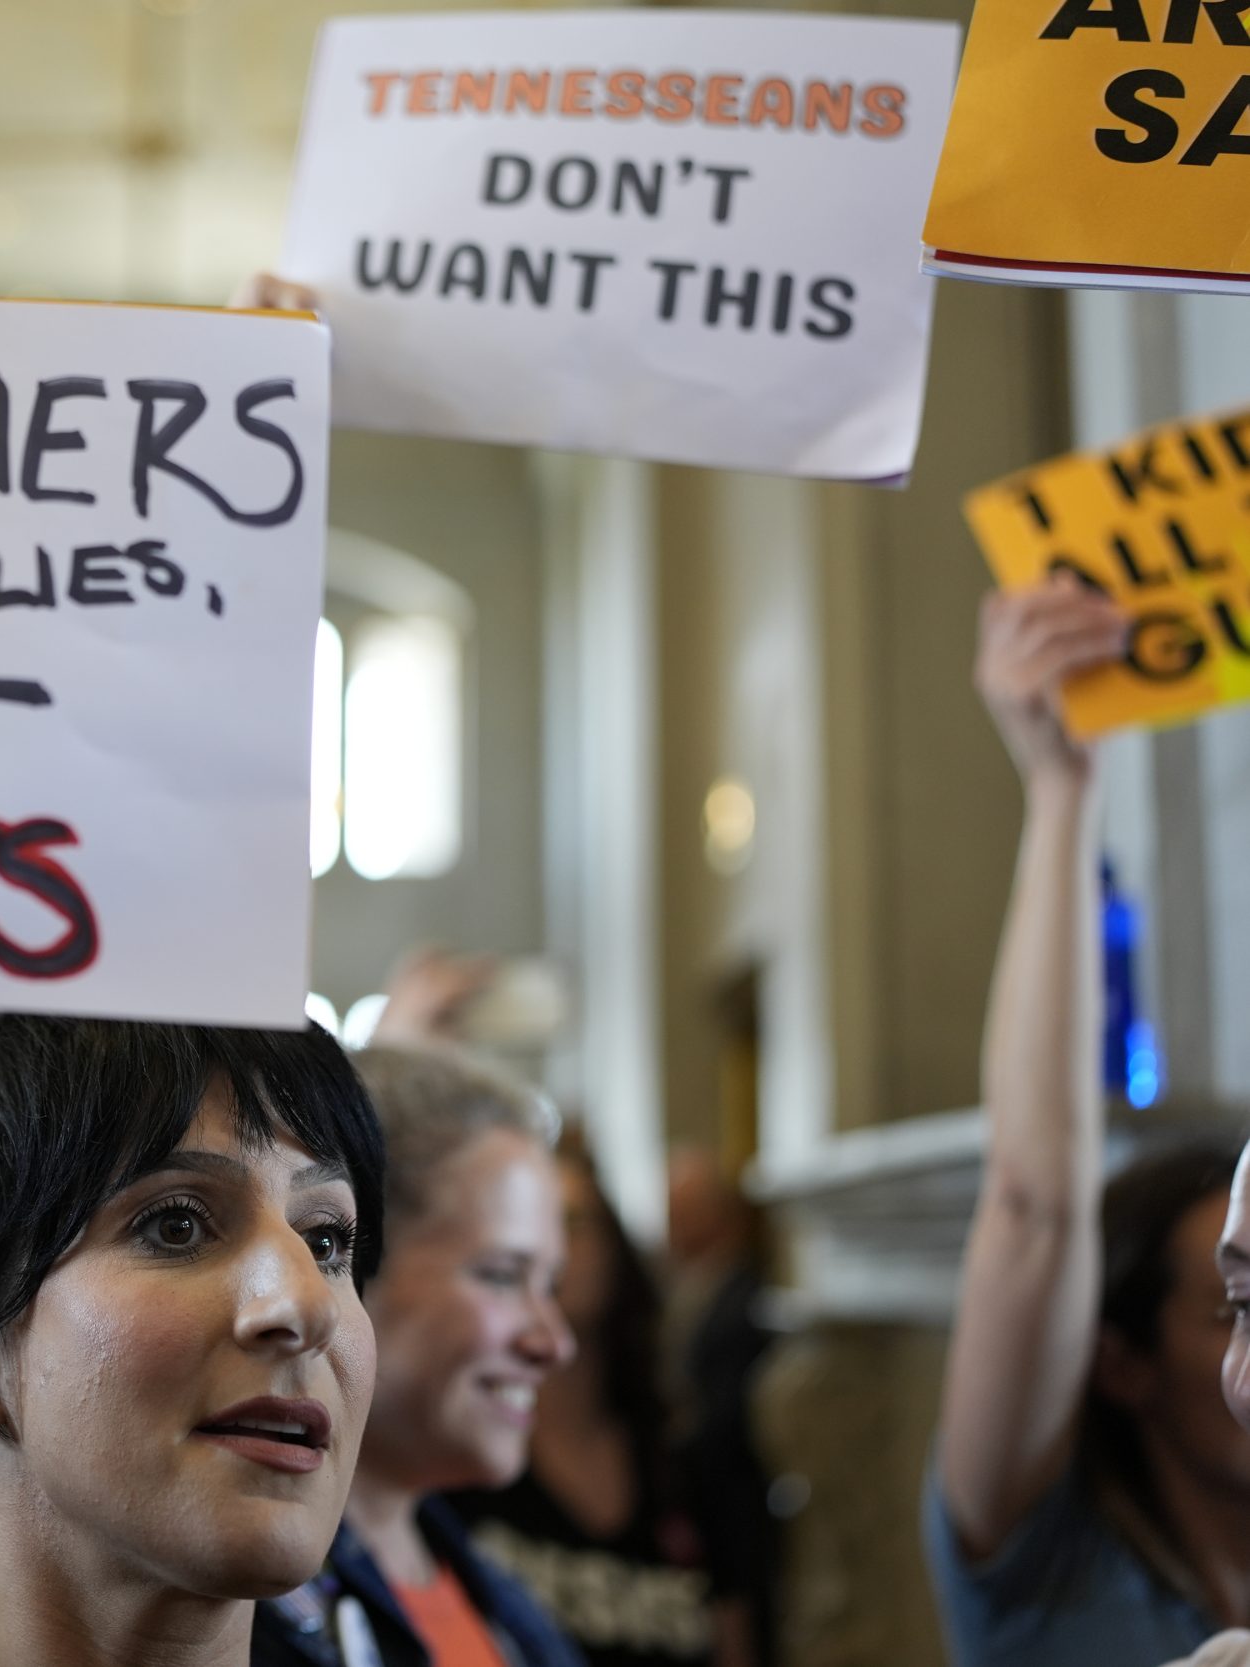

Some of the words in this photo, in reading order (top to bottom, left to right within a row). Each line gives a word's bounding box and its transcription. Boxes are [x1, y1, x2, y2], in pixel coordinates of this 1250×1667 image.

[361, 70, 908, 138] TENNESSEANS
[1094, 68, 1250, 166] SA
[482, 153, 751, 224] DON'T
[356, 237, 616, 313] WANT
[647, 258, 858, 341] THIS
